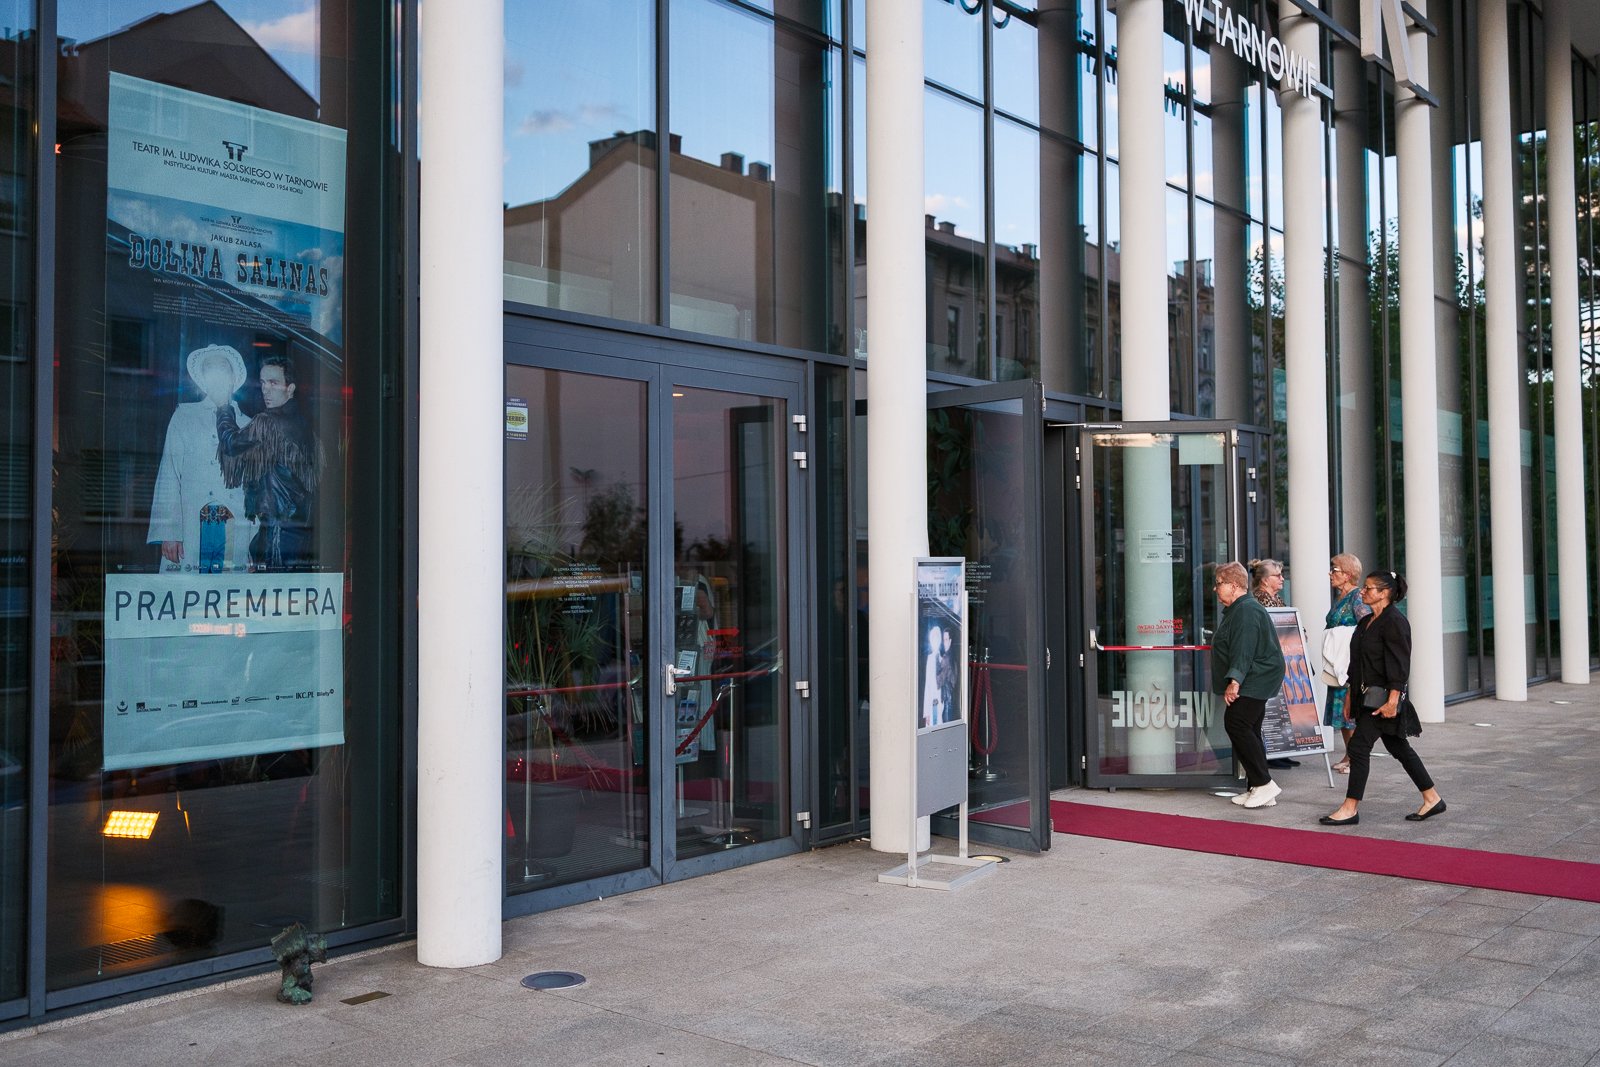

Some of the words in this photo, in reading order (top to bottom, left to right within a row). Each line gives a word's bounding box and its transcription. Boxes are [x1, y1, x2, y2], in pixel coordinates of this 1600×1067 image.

[1212, 0, 1318, 103] TARNOWIE
[132, 141, 160, 156] TEATR
[162, 147, 177, 159] IM.
[179, 150, 221, 169] LUDWIKA
[223, 160, 272, 180] SOLSKIEGO
[273, 171, 284, 181] W
[285, 174, 328, 192] TARNOWIE
[163, 159, 197, 172] INSTYTUCJA
[197, 166, 219, 176] KULTURY
[219, 172, 239, 181] MIASTA
[239, 176, 266, 187] TARNOWA
[266, 181, 276, 189] OD
[289, 186, 304, 195] ROKU
[210, 233, 234, 244] JAKUB
[235, 238, 263, 249] ZALASA
[129, 233, 224, 280] DOLINA
[237, 252, 329, 297] SALINAS
[115, 587, 336, 621] PRAPREMIERA
